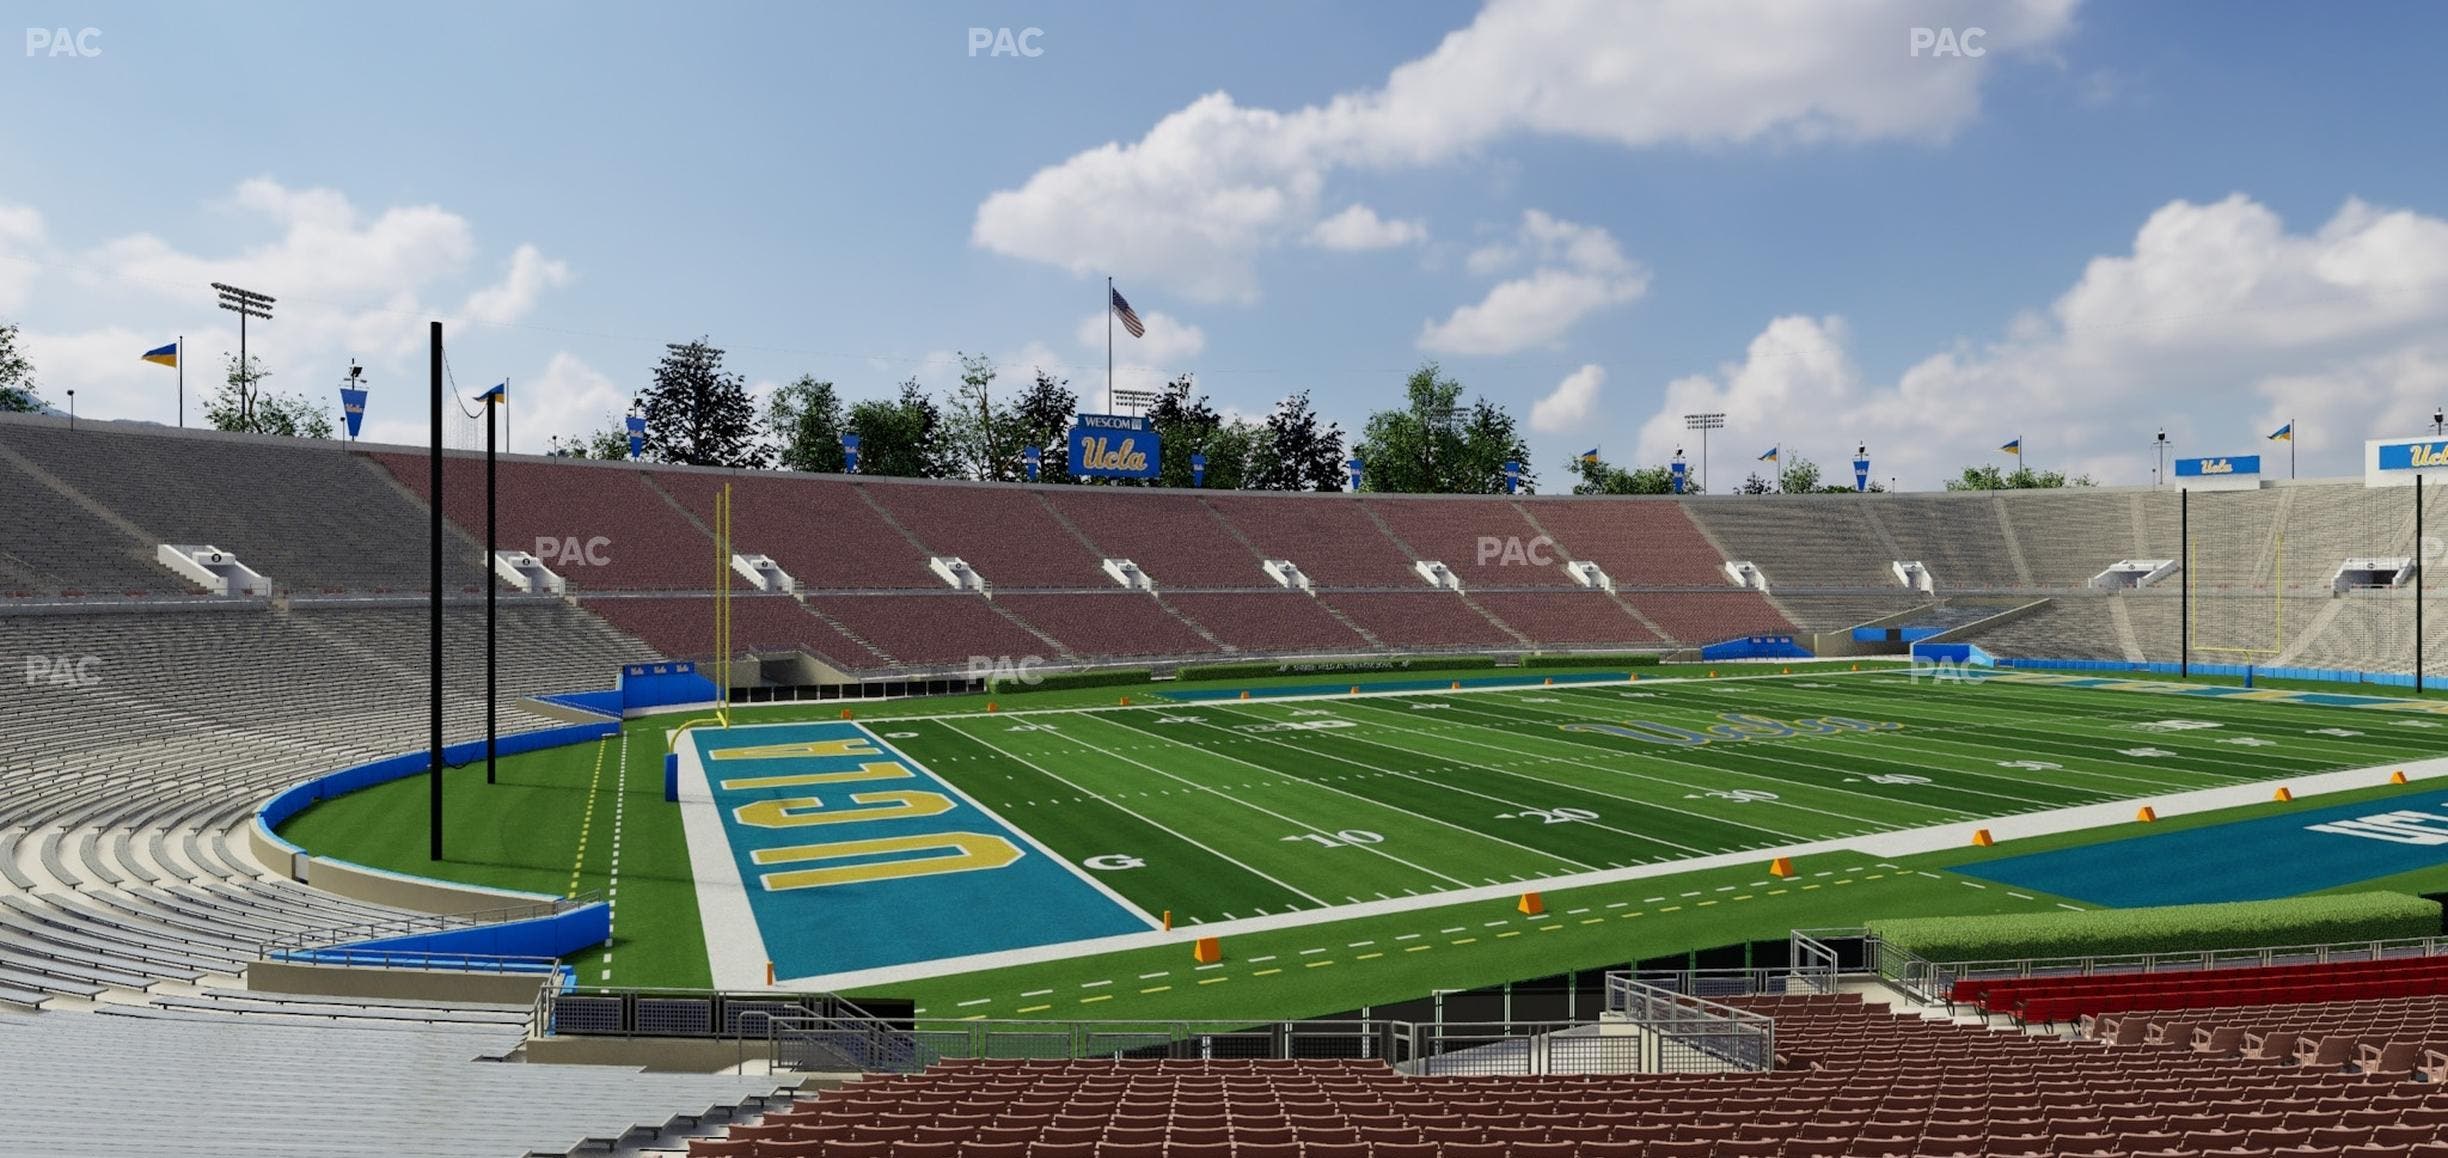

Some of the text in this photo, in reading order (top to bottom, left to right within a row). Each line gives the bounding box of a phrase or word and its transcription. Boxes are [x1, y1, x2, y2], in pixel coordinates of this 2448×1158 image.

[1084, 417, 1131, 429] WESCOM
[1081, 437, 1148, 471] Ucla
[708, 738, 1027, 891] UCLA
[1518, 807, 1600, 824] 20
[1302, 829, 1385, 848] 10
[1083, 854, 1147, 870] G
